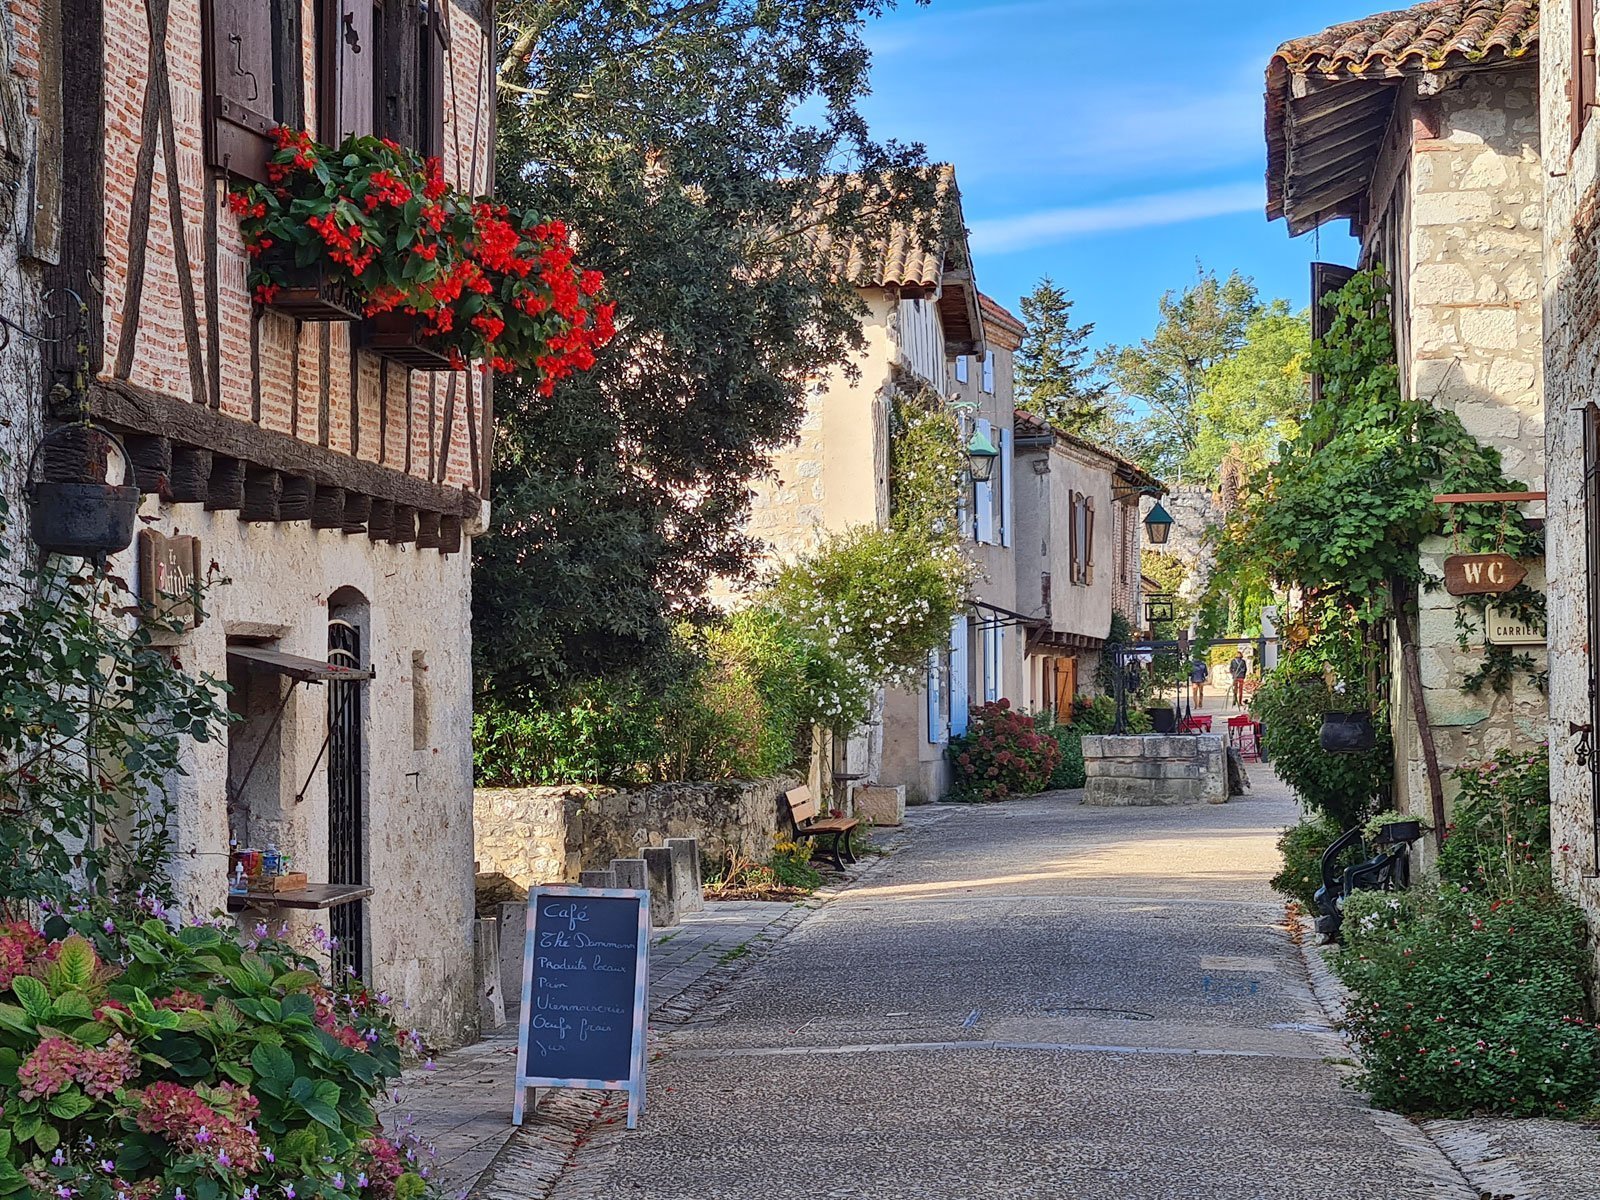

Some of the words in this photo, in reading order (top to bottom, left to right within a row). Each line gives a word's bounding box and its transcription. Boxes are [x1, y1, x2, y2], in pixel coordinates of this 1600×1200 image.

[1463, 562, 1504, 583] WC
[544, 903, 590, 931] Café
[540, 931, 571, 948] Thé
[593, 954, 626, 973] locaux
[537, 977, 568, 988] Pain
[579, 1018, 612, 1041] frais
